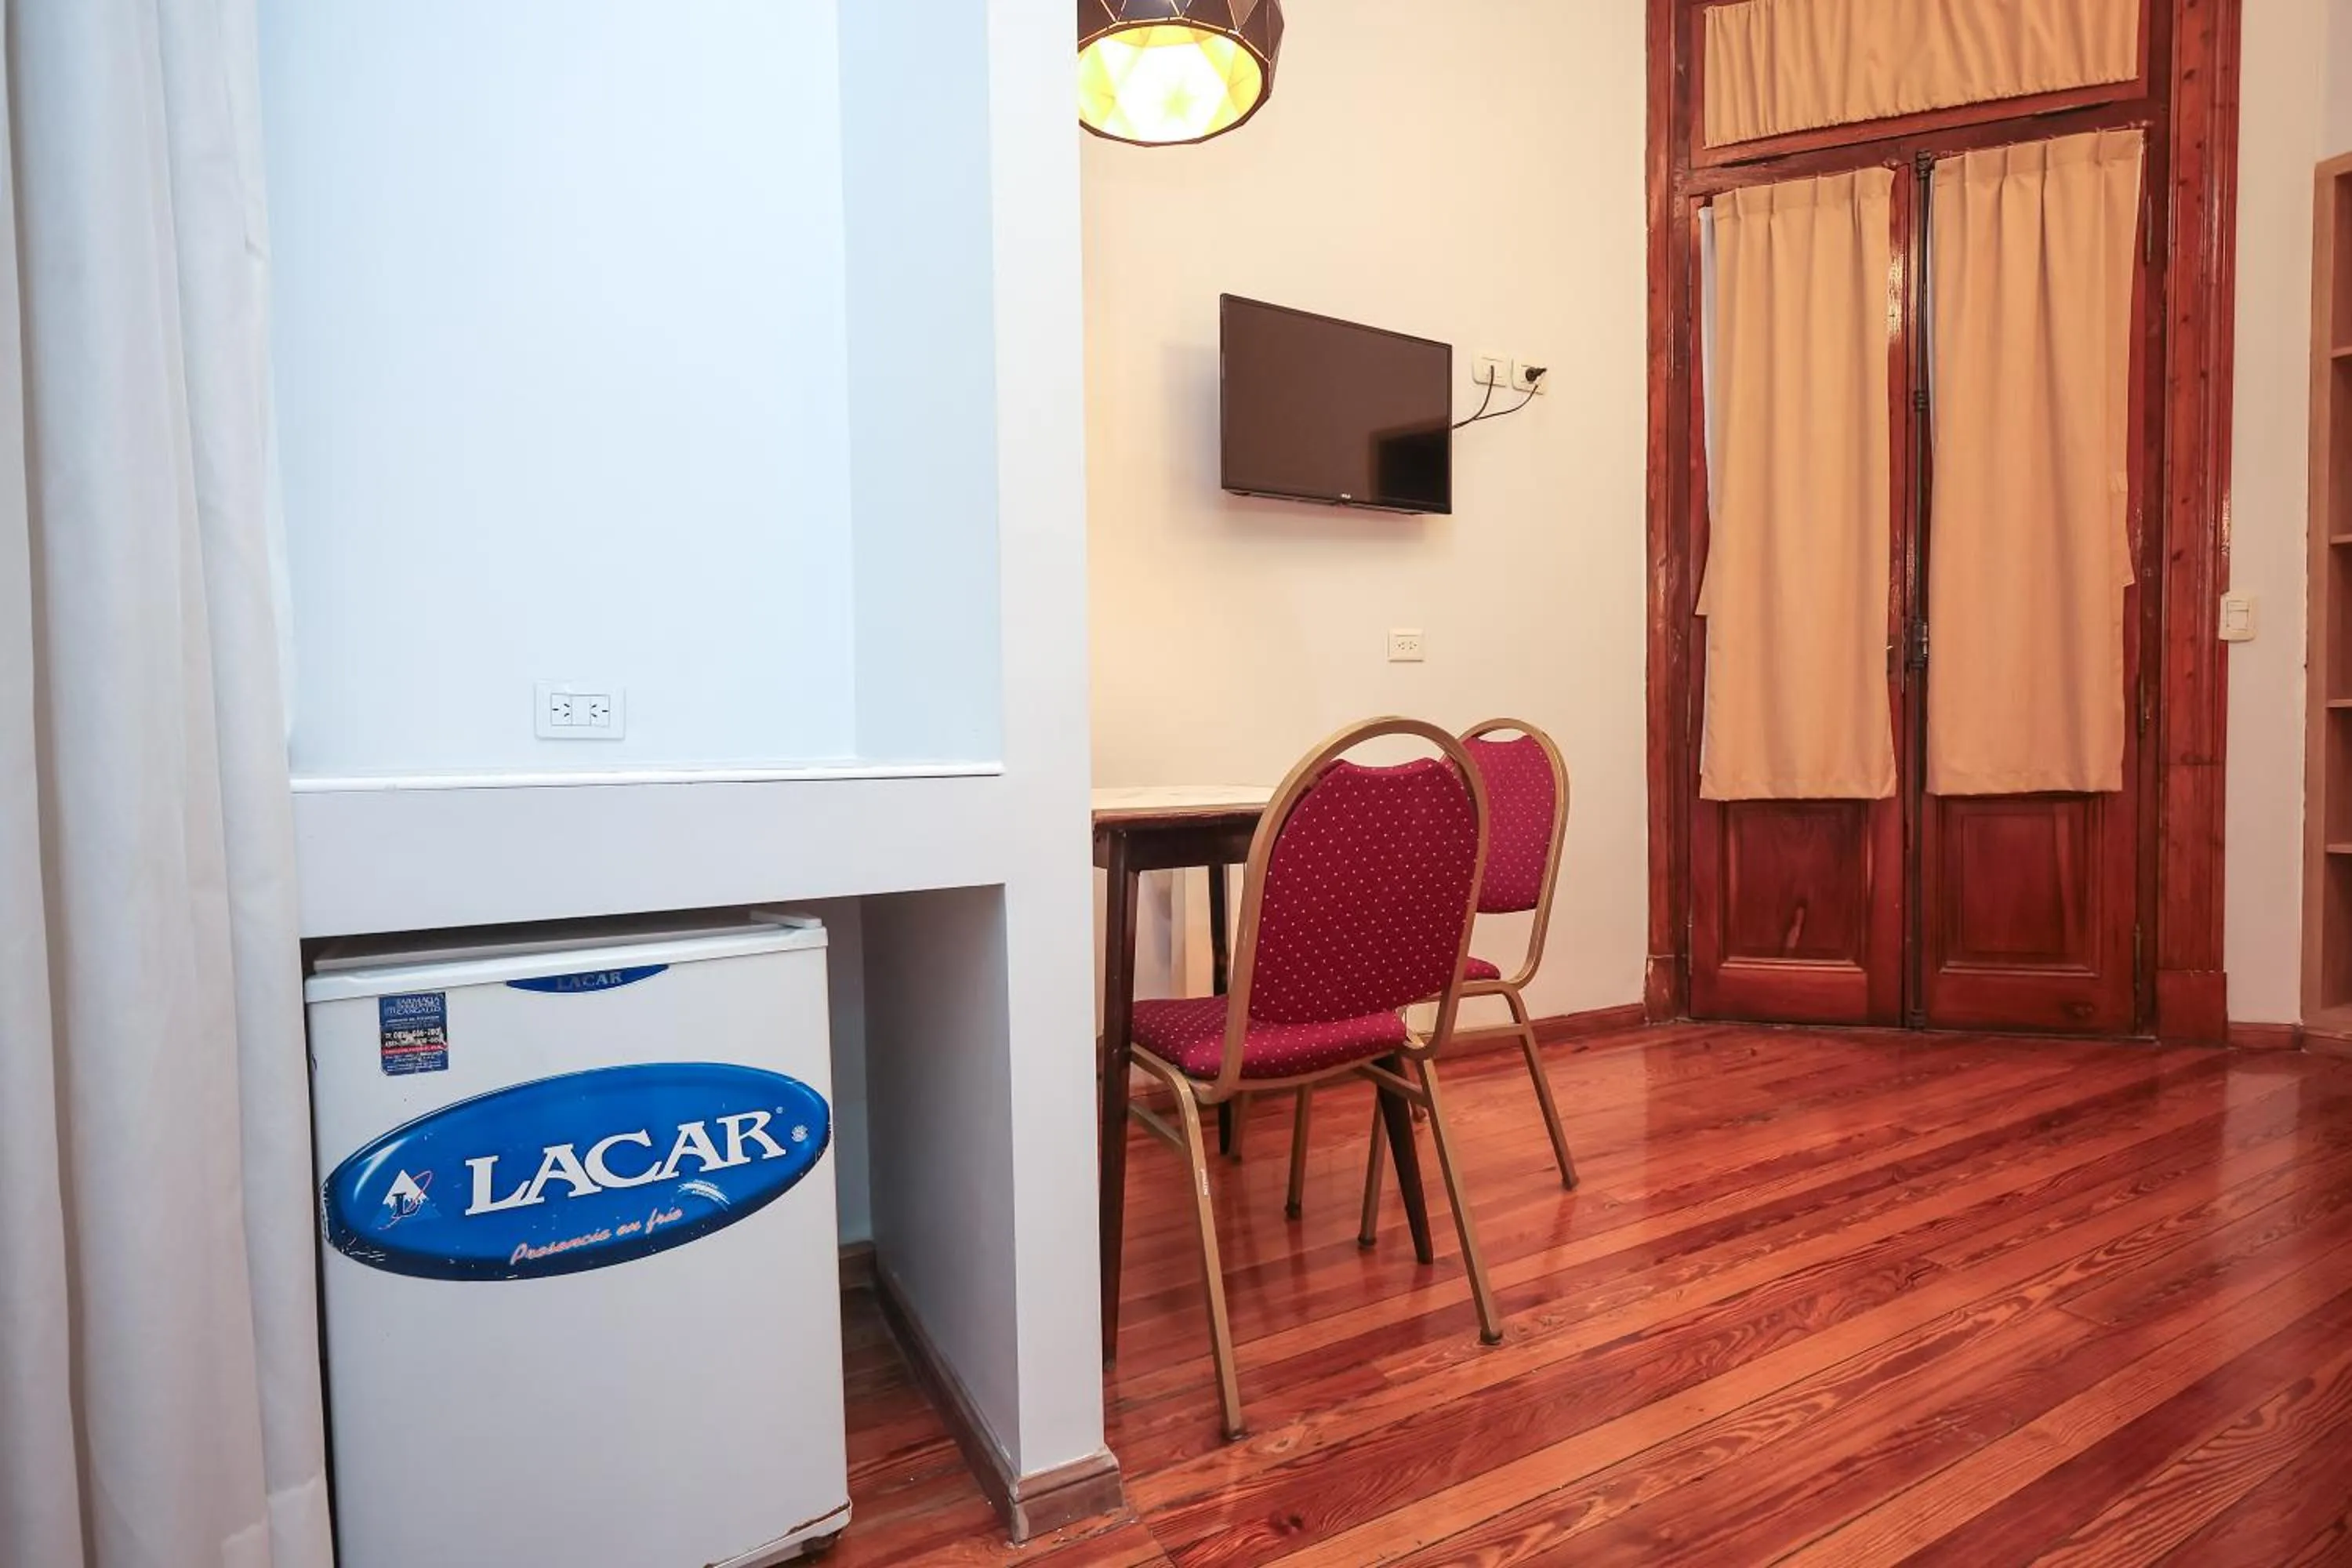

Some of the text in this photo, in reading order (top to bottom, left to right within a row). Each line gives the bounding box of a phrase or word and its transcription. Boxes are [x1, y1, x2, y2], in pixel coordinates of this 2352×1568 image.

[556, 971, 623, 993] LACAR
[465, 1110, 786, 1216] LACAR
[510, 1227, 612, 1266] Presencia
[615, 1220, 642, 1236] en
